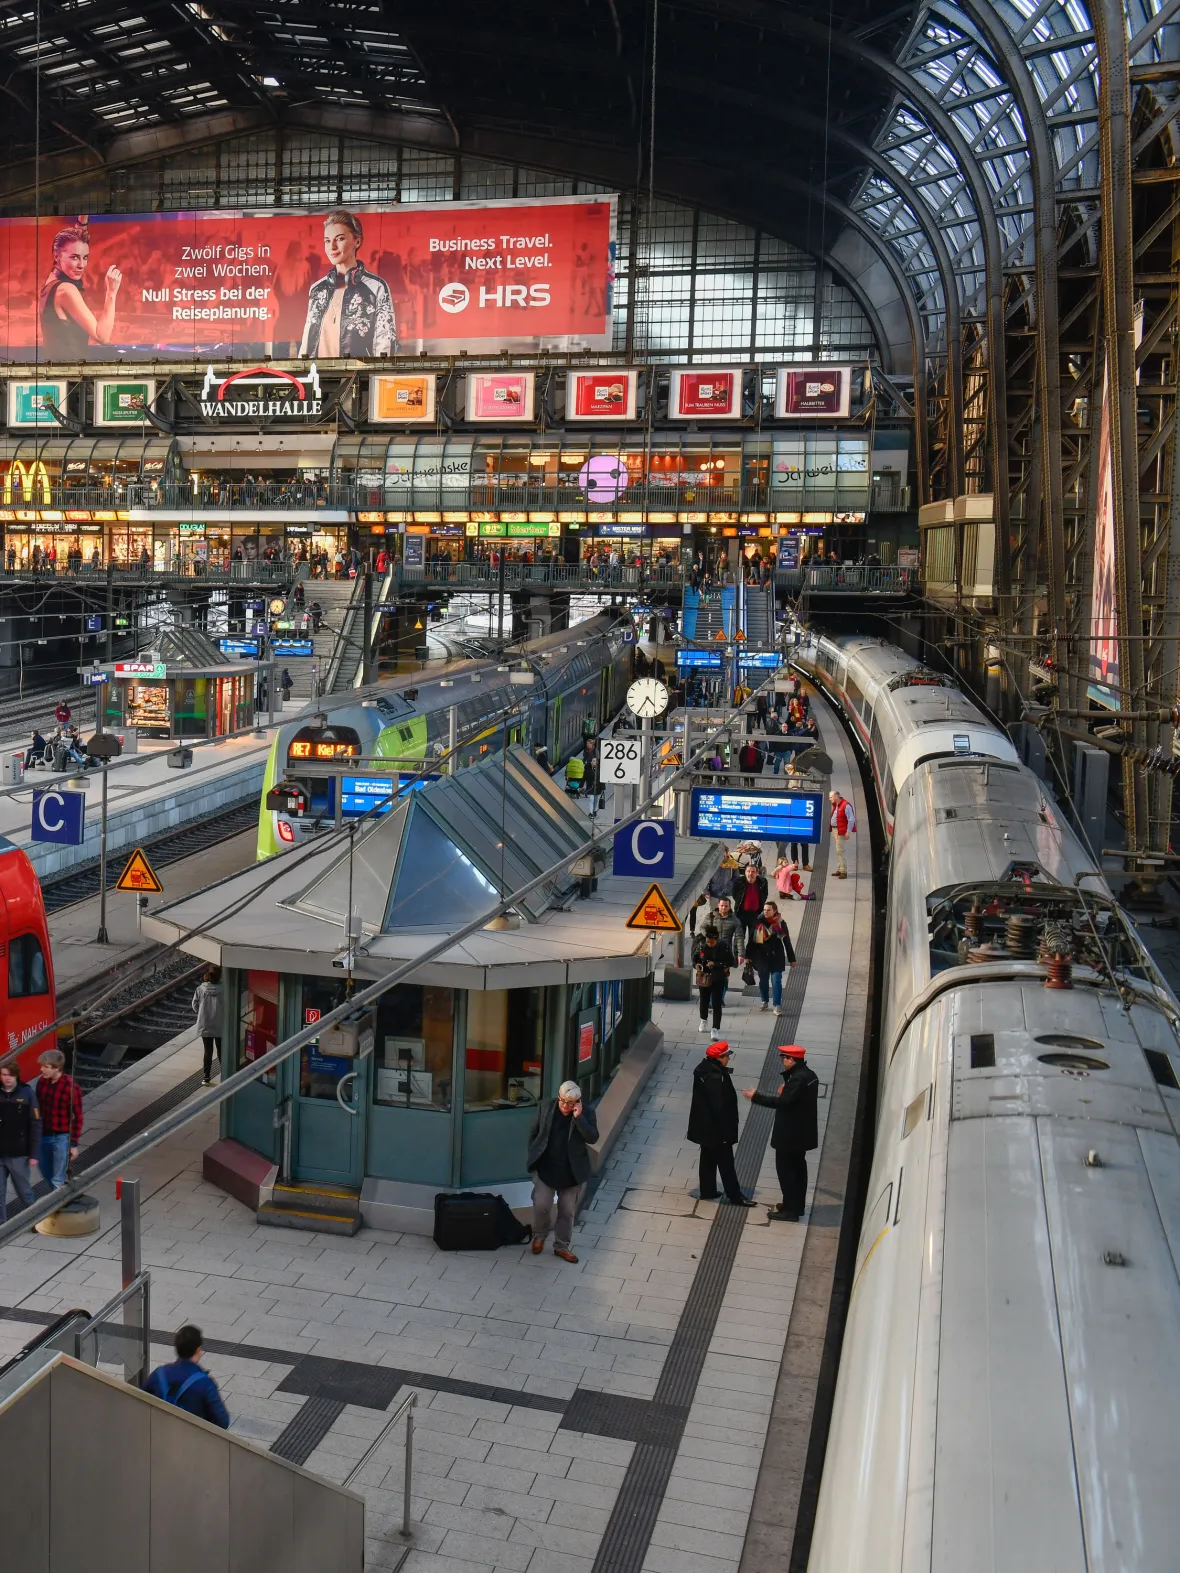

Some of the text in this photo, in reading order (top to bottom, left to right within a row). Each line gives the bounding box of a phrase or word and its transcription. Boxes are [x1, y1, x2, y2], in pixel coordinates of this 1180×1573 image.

[430, 234, 552, 252] Business Travel.
[182, 244, 270, 260] Zwölf Gigs in
[465, 253, 552, 270] Next Level.
[175, 264, 272, 278] zwei Wochen.
[142, 286, 270, 302] Null Stress bei der
[479, 284, 550, 308] HRS
[172, 306, 272, 321] Reiseplanung.
[200, 400, 322, 416] WANDELHALLE
[88, 618, 95, 628] E
[257, 623, 264, 633] E
[293, 742, 310, 756] RE7
[318, 744, 334, 756] Kiel
[604, 742, 637, 760] 286
[614, 762, 625, 779] 6
[38, 792, 64, 832] C
[806, 800, 814, 812] 5
[631, 822, 664, 865] C
